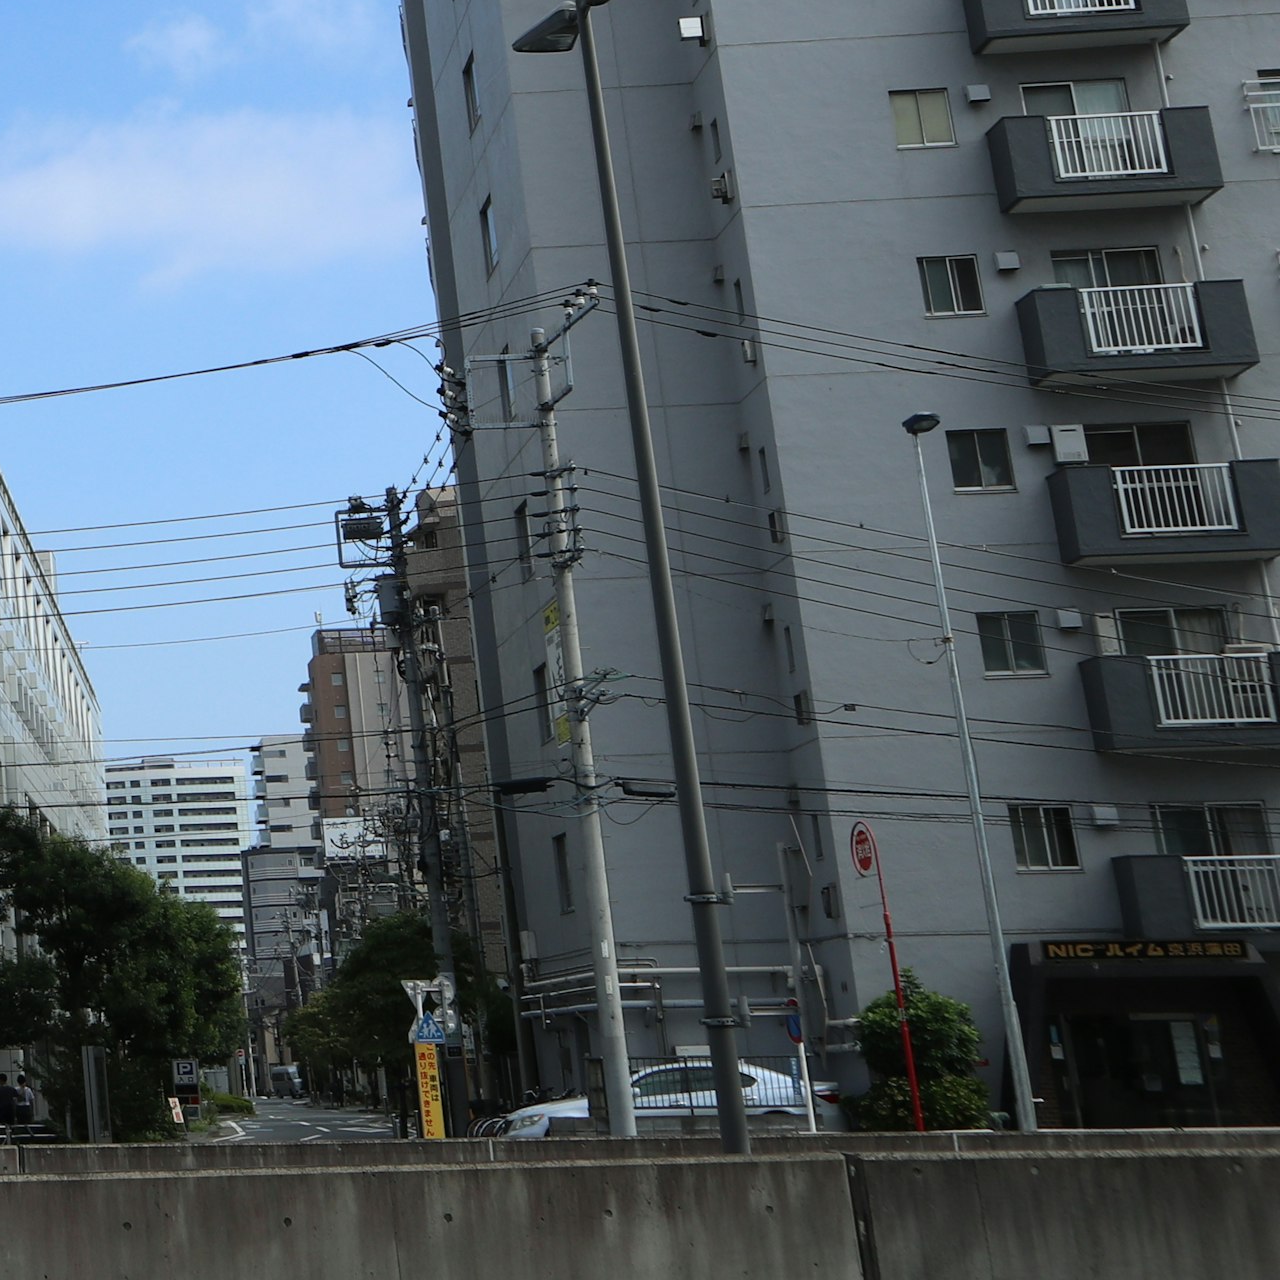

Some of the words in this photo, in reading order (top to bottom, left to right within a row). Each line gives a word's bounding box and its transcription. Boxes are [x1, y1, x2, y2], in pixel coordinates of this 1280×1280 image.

[1047, 943, 1095, 957] NIC
[178, 1063, 192, 1075] P
[418, 1052, 435, 1137] 通り抜けできません
[429, 1074, 440, 1102] 車両は
